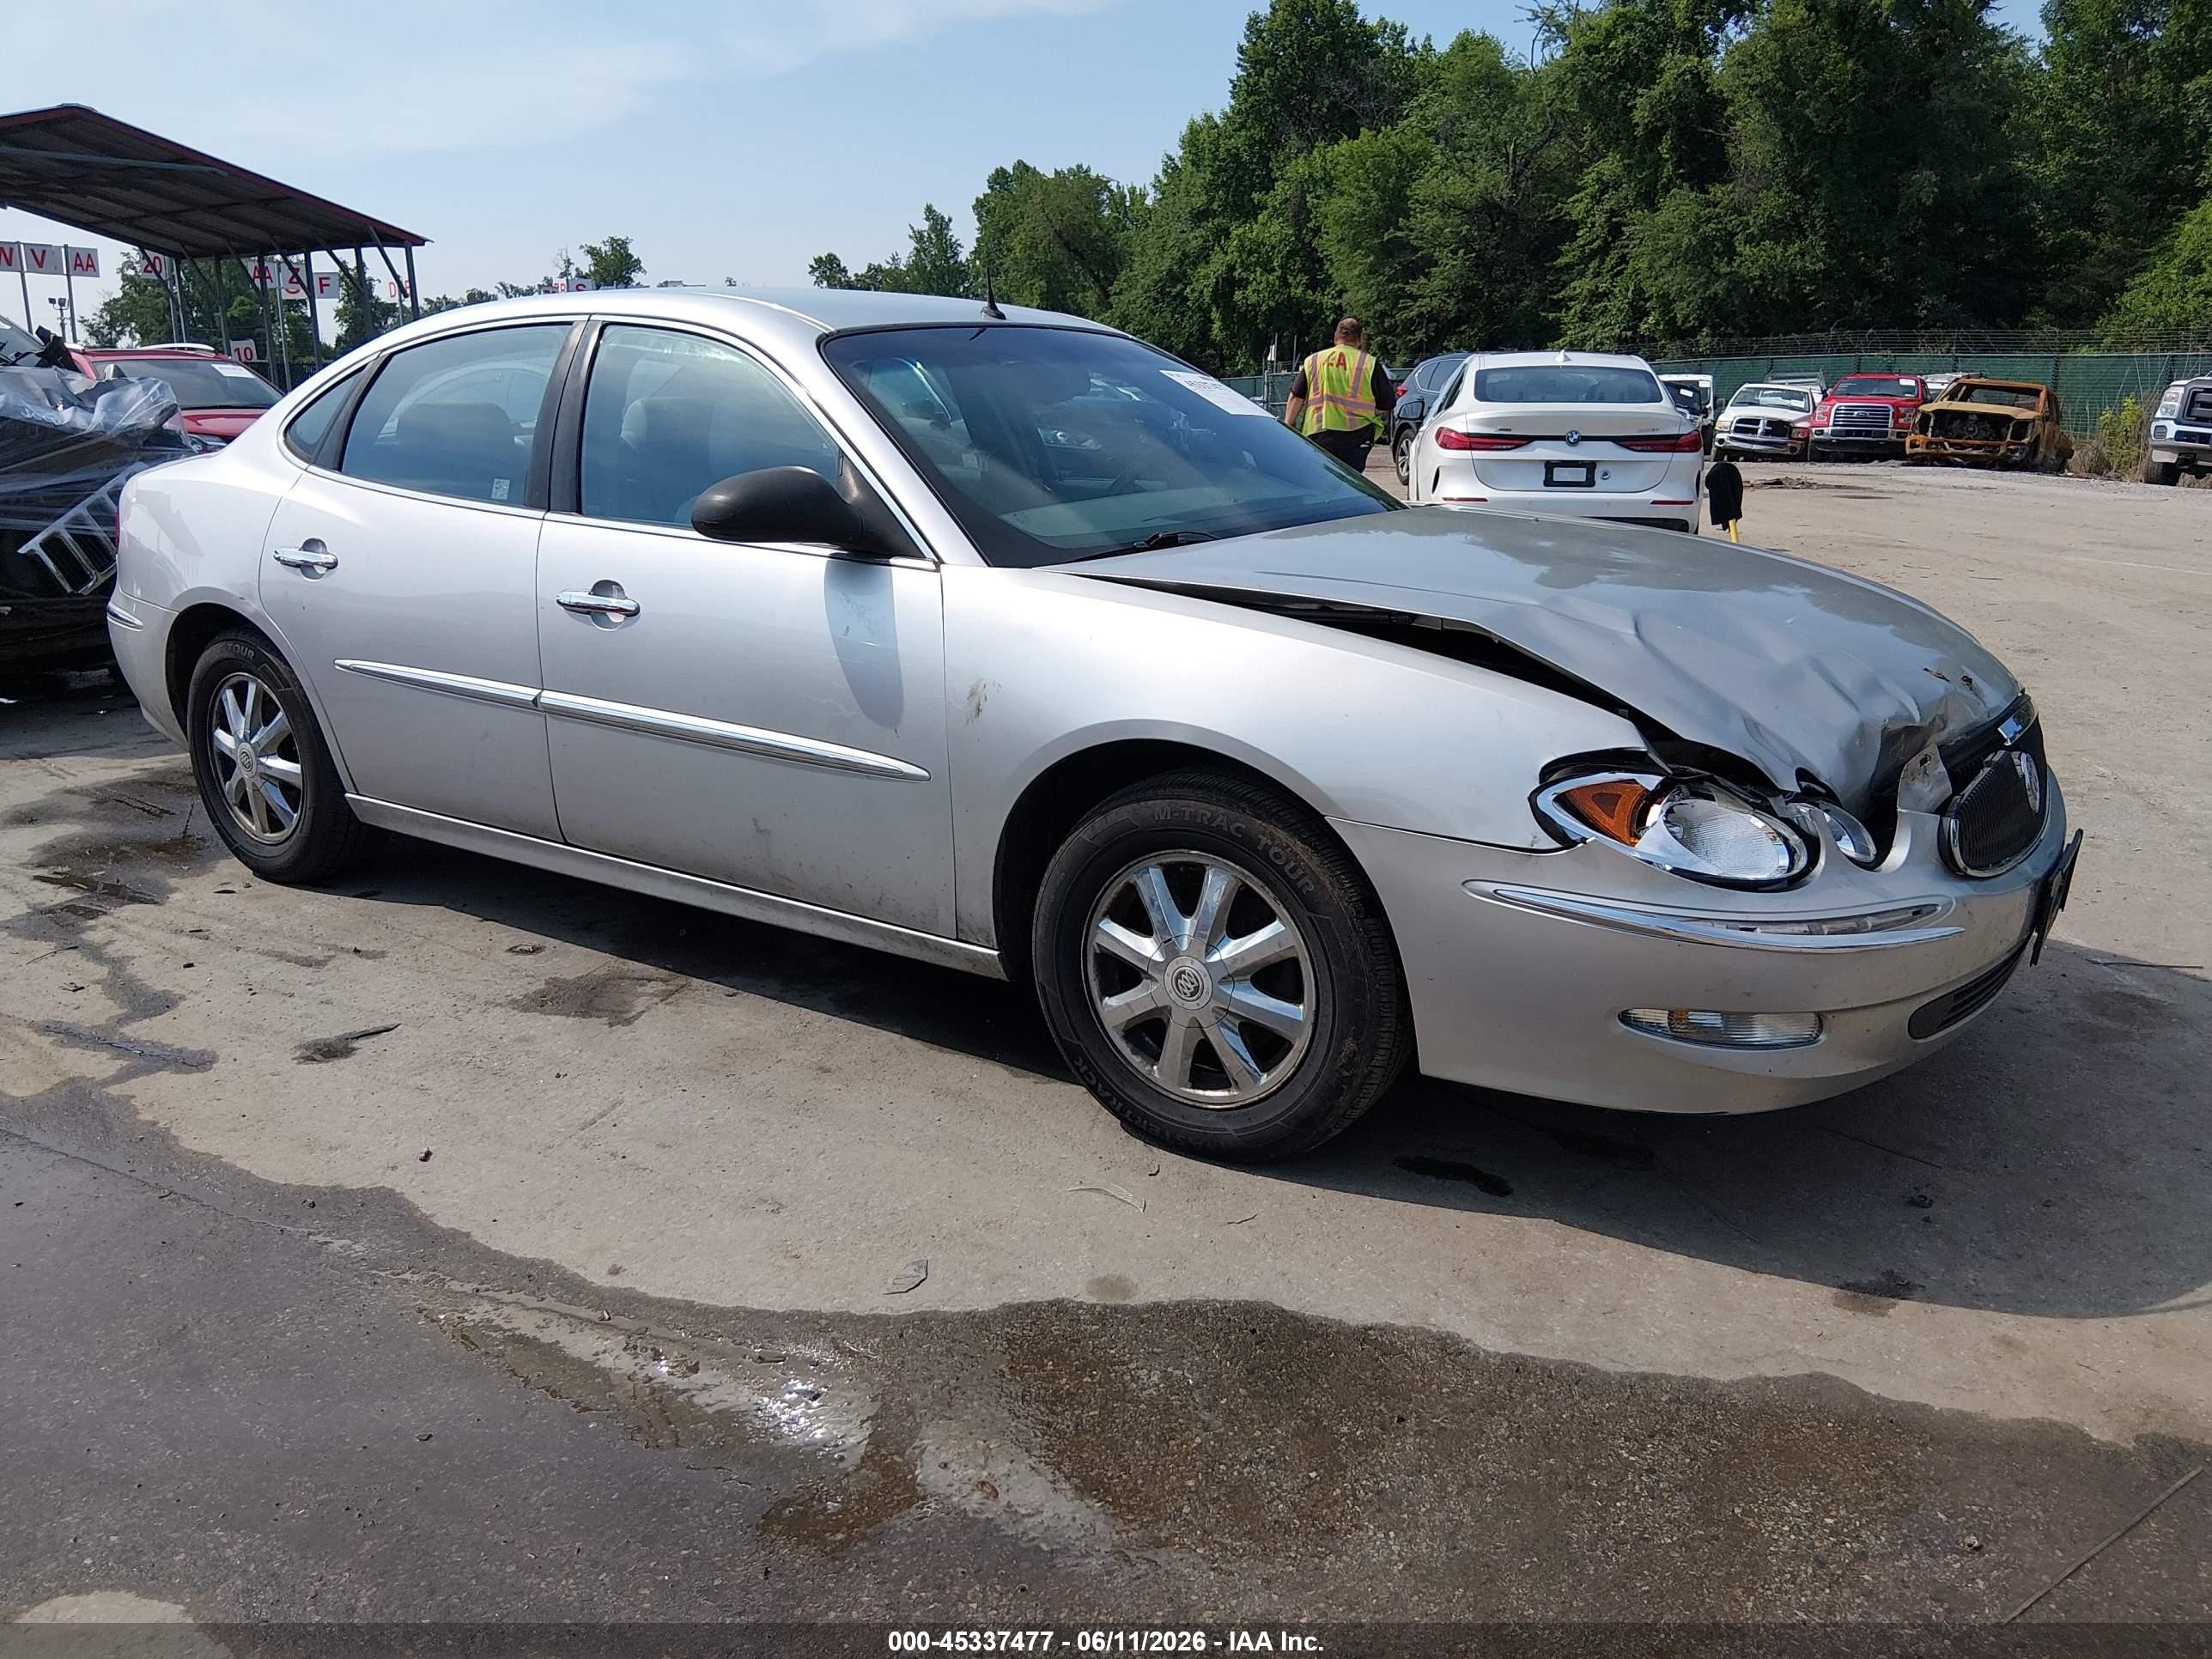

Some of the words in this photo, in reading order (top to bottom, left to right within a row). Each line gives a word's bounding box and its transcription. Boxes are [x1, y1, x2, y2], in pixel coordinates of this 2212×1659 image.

[30, 248, 46, 268] V
[74, 252, 96, 272] AA
[319, 276, 331, 294] F
[234, 346, 253, 362] 10
[227, 643, 254, 660] TOUR
[1154, 805, 1246, 838] M-TRAC
[1256, 834, 1314, 895] TOUR
